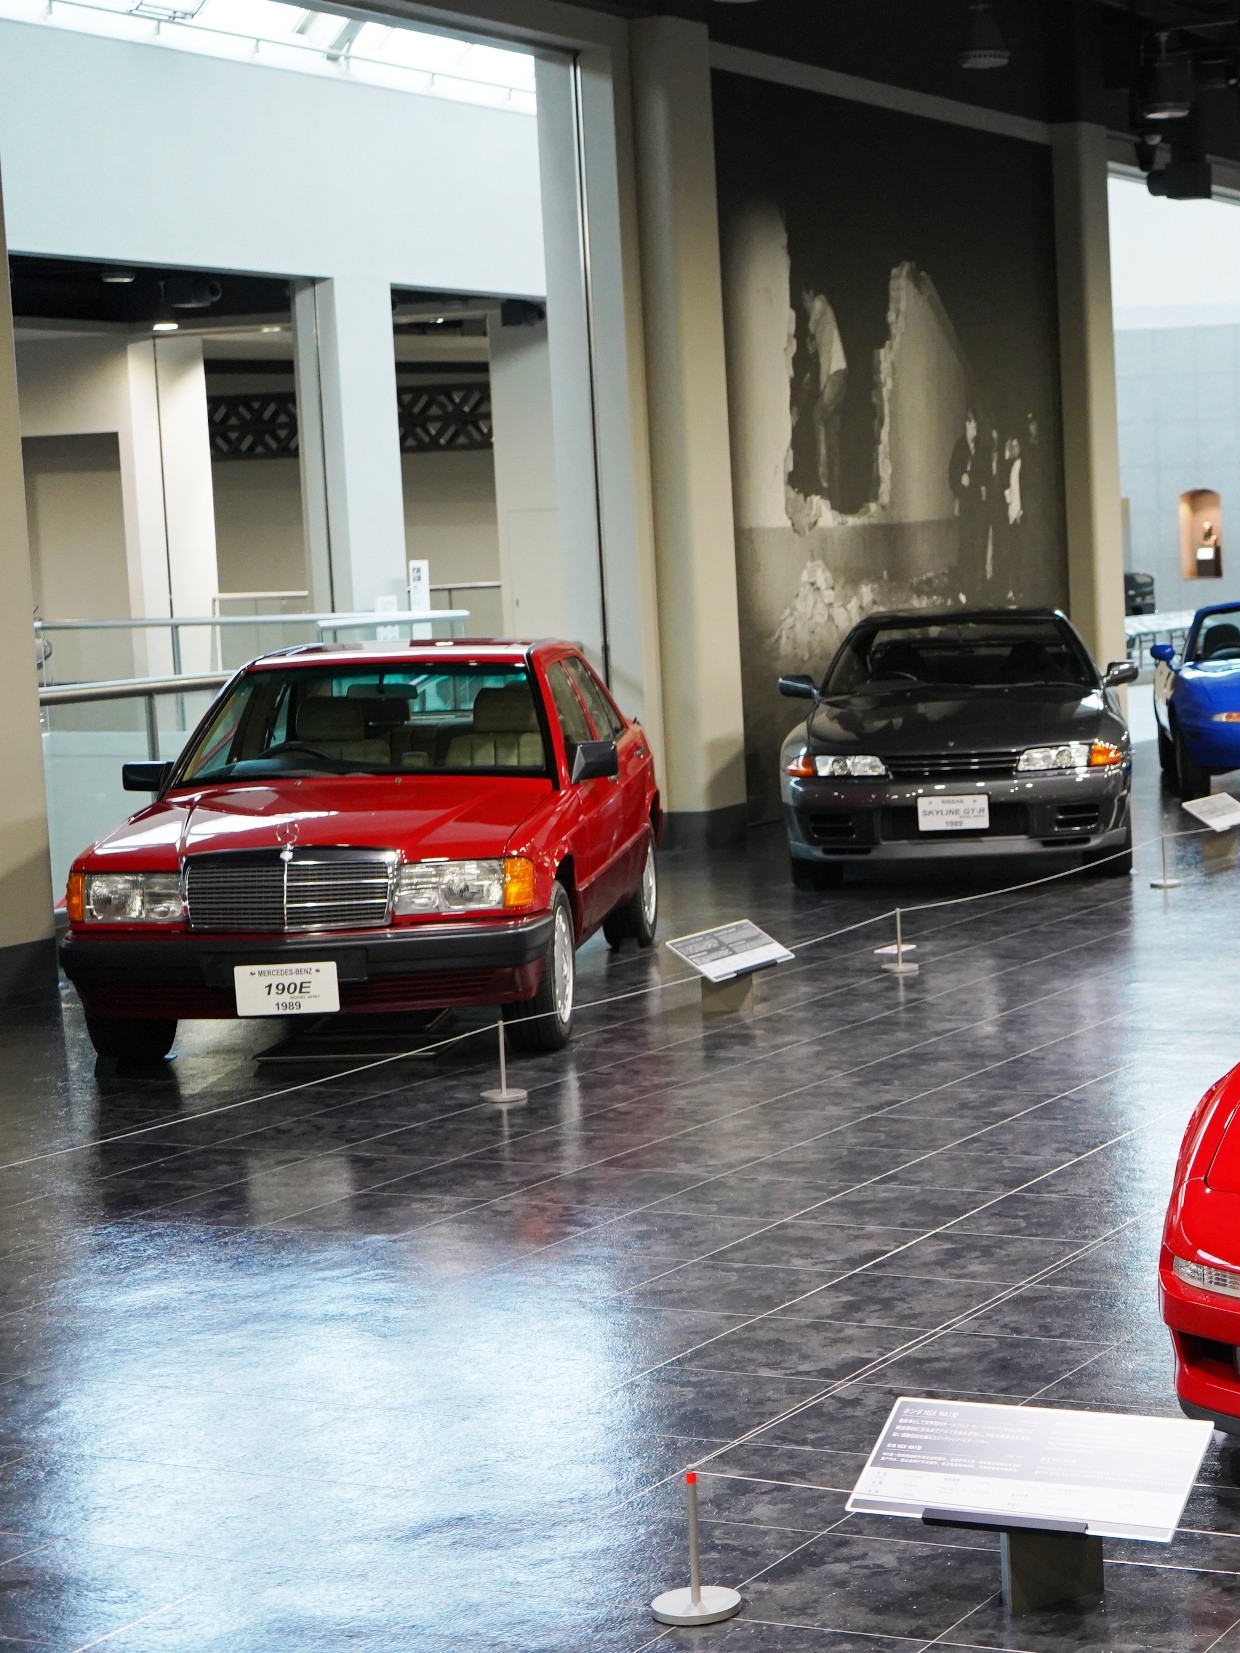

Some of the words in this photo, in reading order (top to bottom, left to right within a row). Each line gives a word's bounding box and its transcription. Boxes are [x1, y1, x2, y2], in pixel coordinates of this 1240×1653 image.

[921, 808, 960, 817] SKYLINE
[963, 807, 986, 815] GT-R
[945, 820, 963, 828] 1989
[257, 968, 313, 977] MERCEDES-BENZ
[264, 981, 312, 996] 190E
[275, 1001, 302, 1011] 1989
[923, 1409, 937, 1417] NSX
